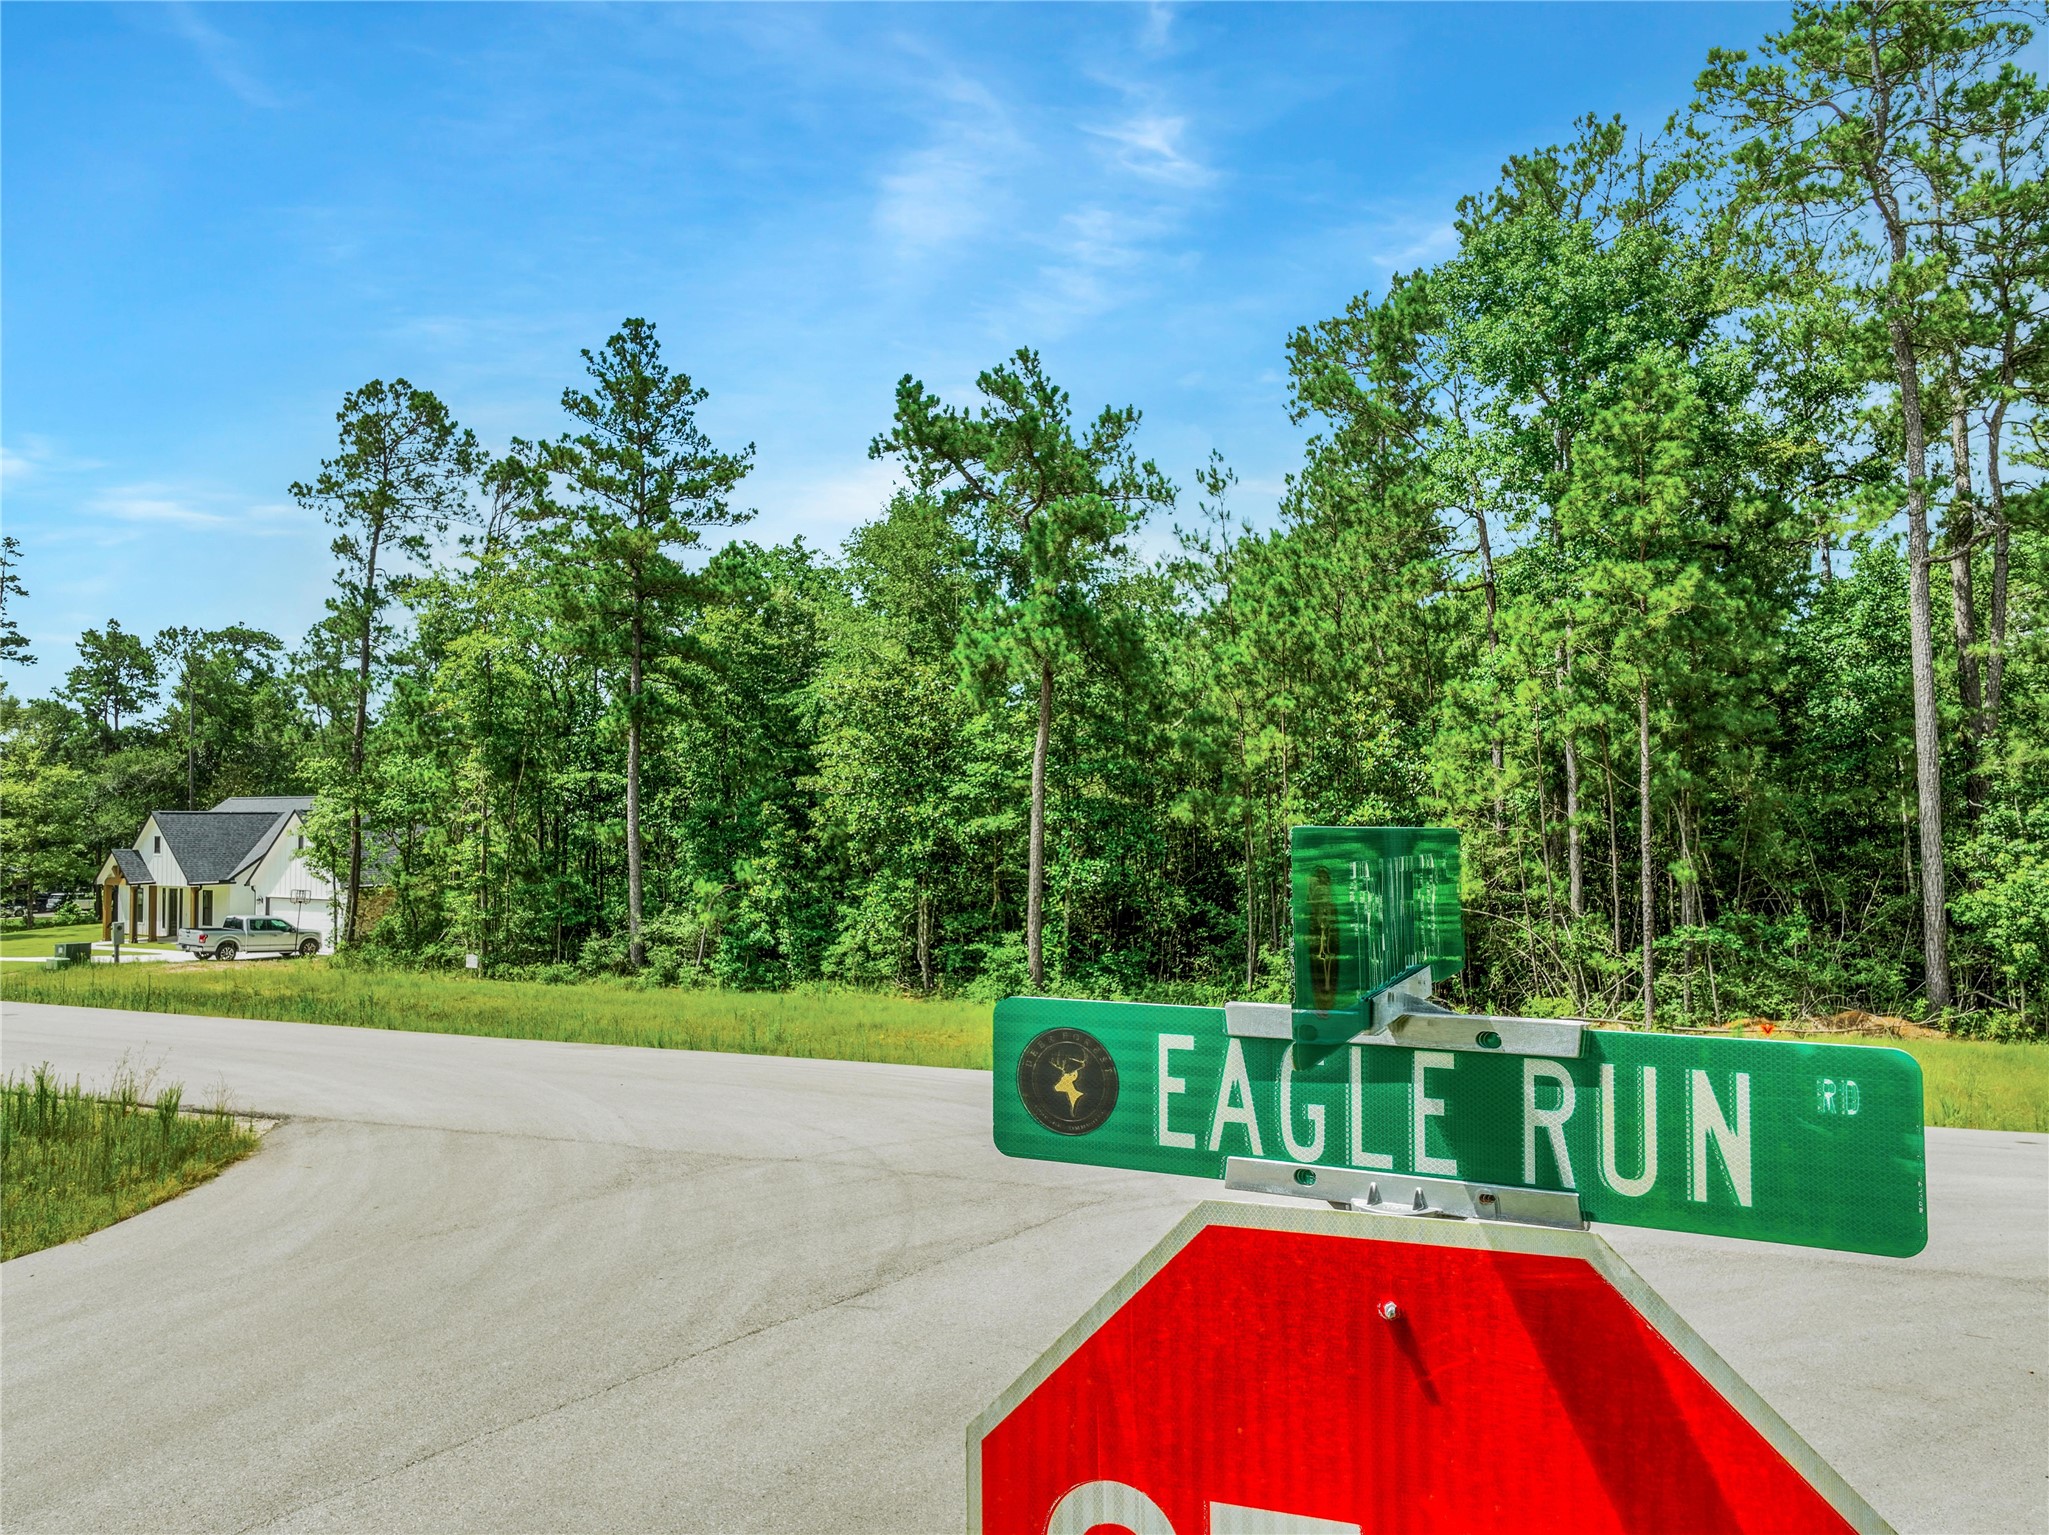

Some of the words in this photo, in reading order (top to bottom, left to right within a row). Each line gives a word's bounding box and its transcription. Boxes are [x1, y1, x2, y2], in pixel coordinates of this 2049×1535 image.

[1158, 1033, 1458, 1176] EAGLE
[1523, 1058, 1753, 1207] RUN
[1822, 1078, 1860, 1115] RD
